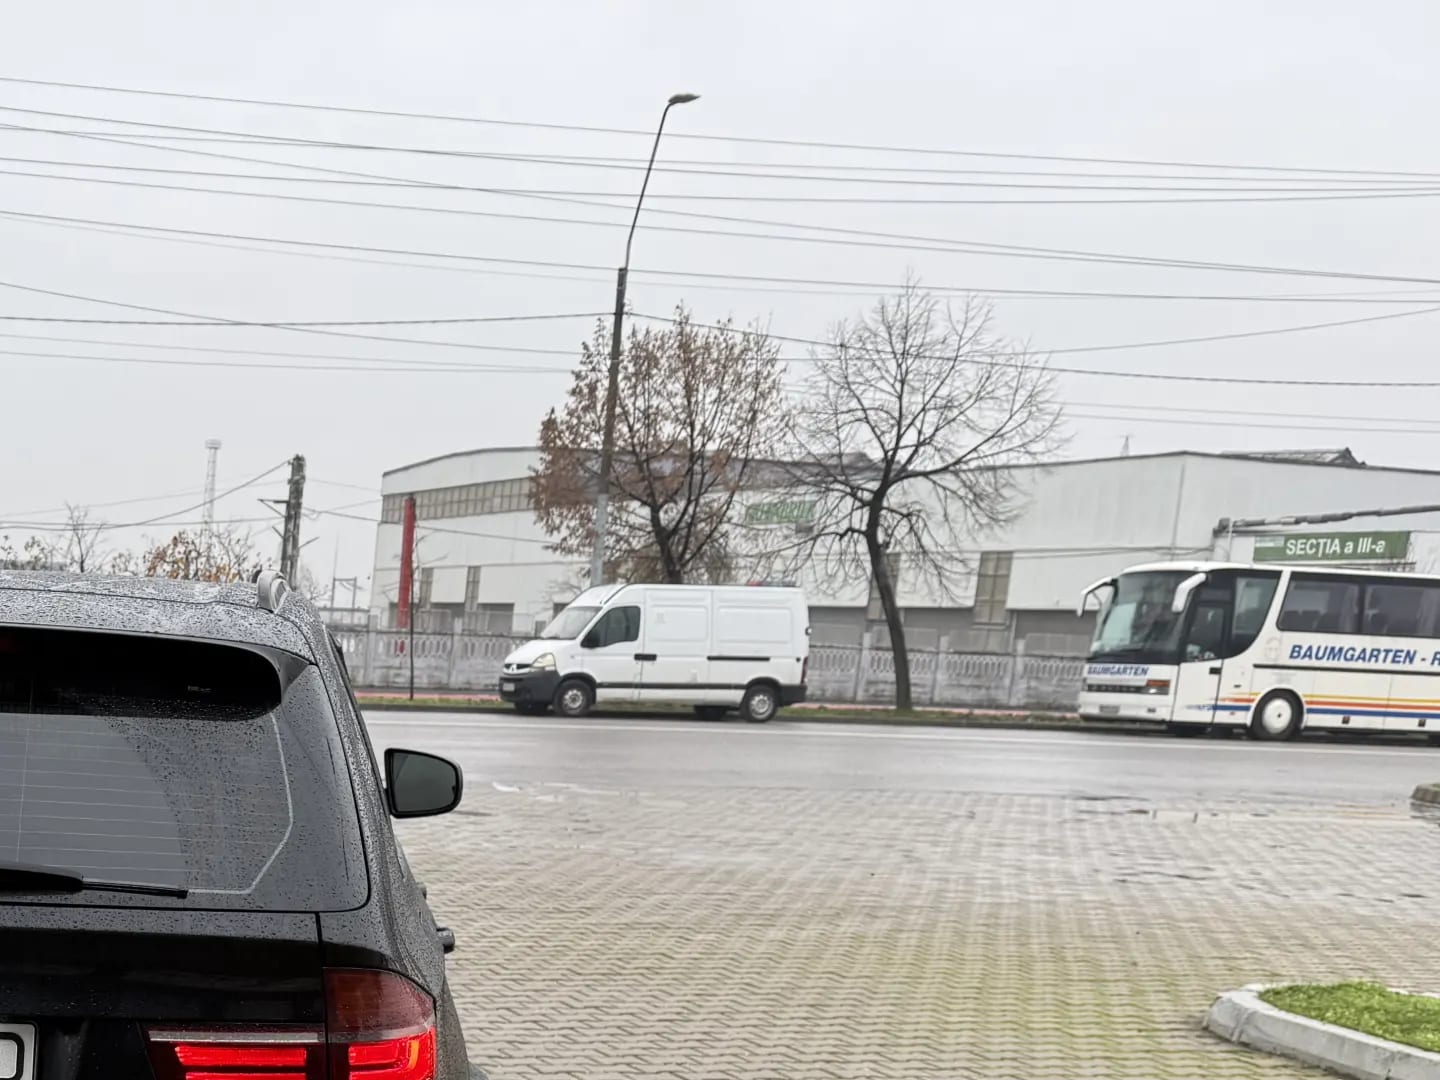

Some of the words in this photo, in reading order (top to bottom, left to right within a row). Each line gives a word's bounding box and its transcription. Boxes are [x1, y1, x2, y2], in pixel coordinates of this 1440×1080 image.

[1344, 542, 1354, 553] a
[1357, 537, 1386, 553] III-a
[1289, 644, 1417, 664] BAUMGARTEN
[1087, 664, 1149, 676] BAUMGARTEN
